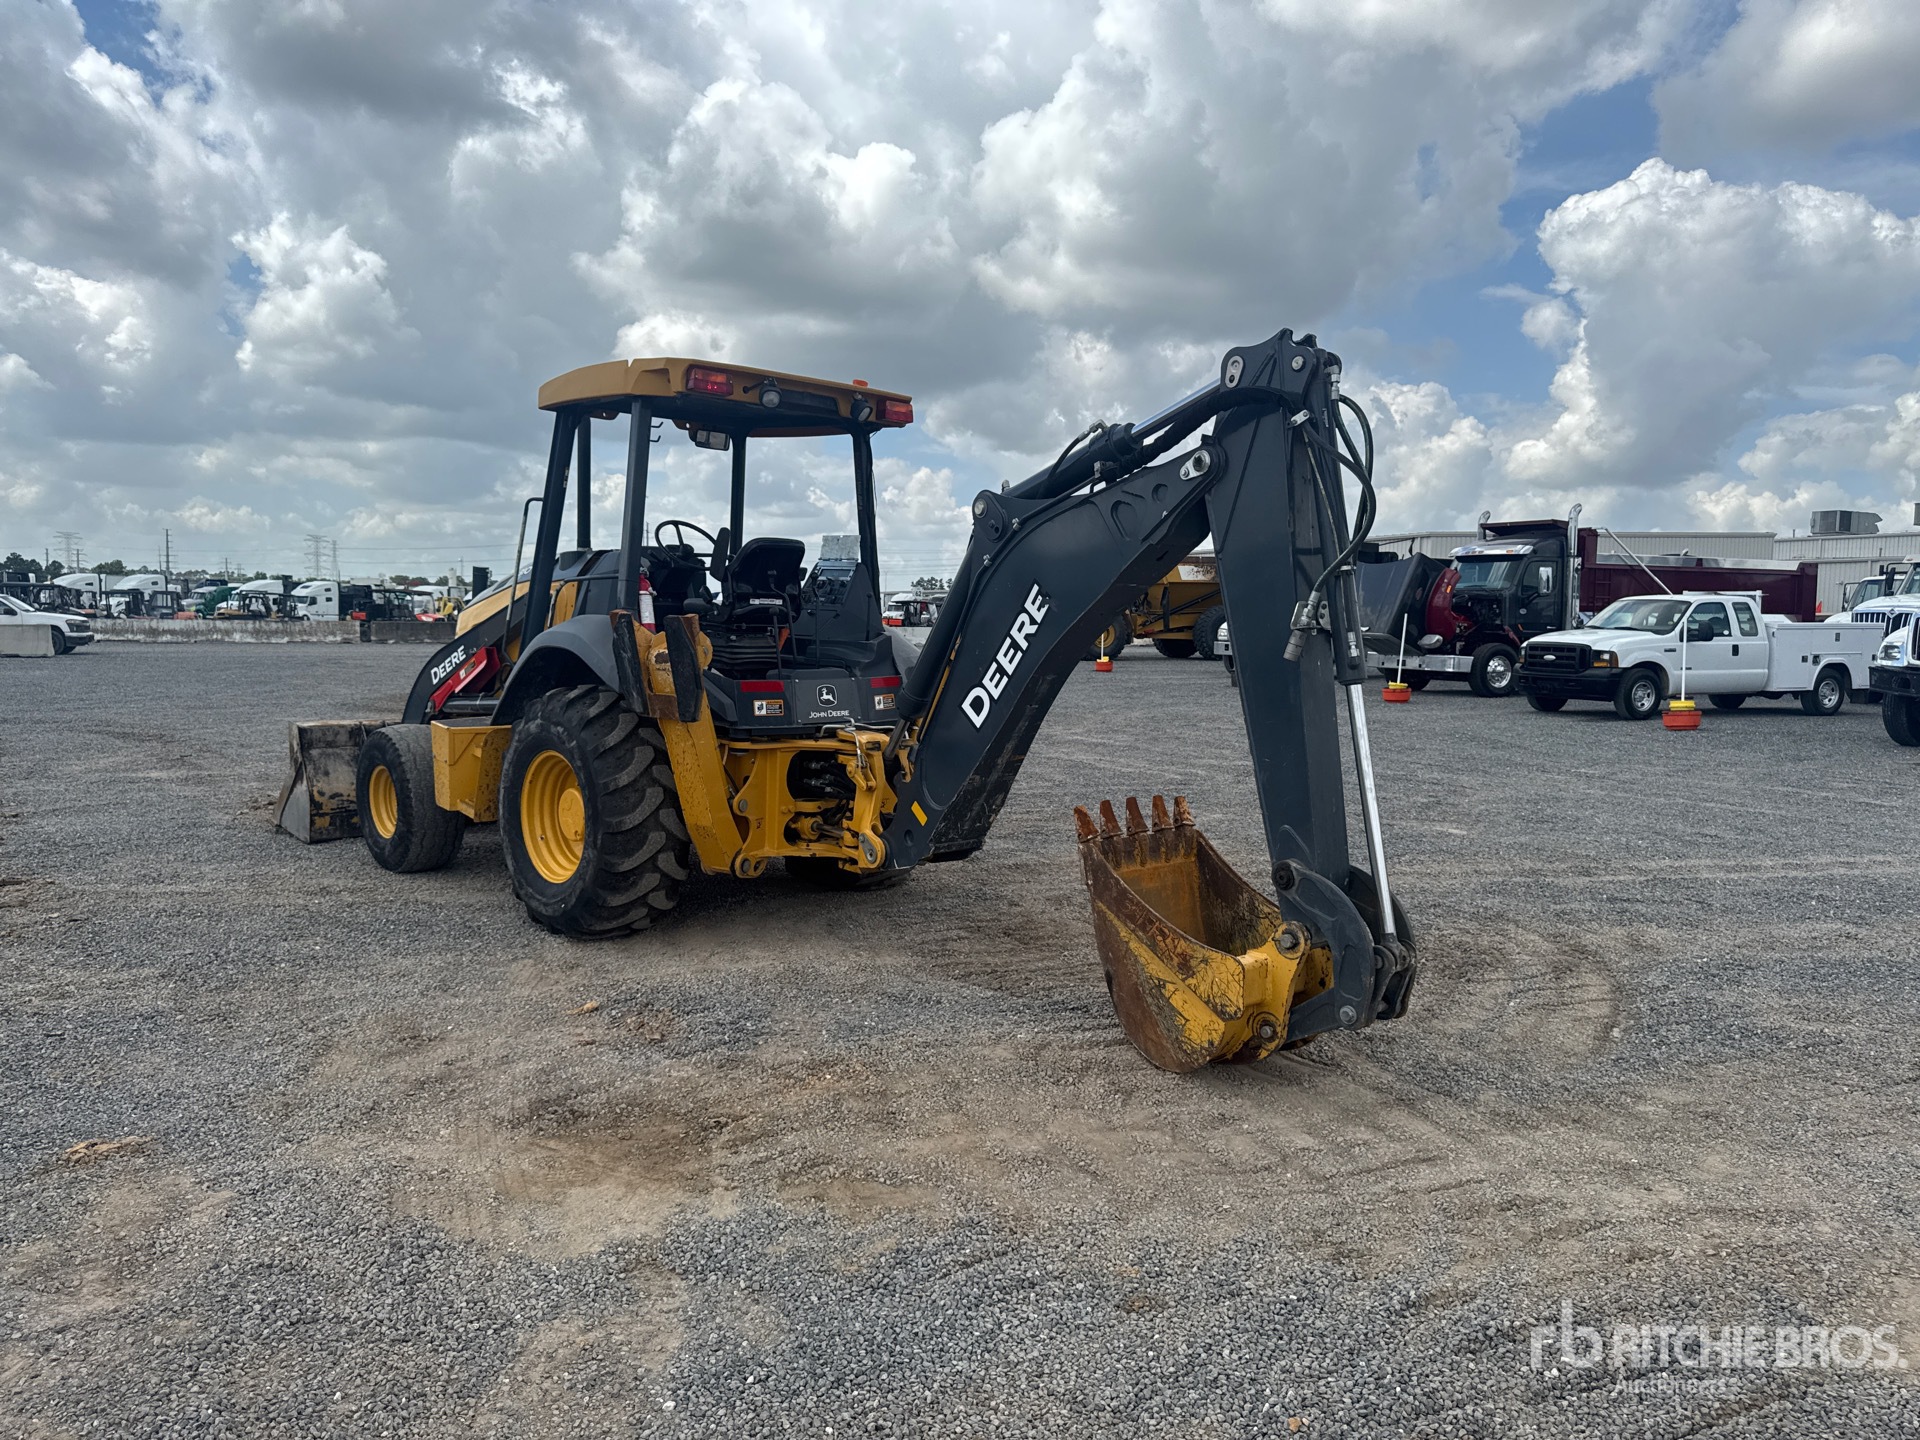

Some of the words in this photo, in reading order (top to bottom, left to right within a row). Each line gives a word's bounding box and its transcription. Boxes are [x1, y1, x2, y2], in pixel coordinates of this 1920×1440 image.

[430, 644, 467, 685] DEERE
[961, 583, 1050, 729] DEERE
[808, 711, 828, 719] JOHN
[827, 709, 850, 717] DEERE
